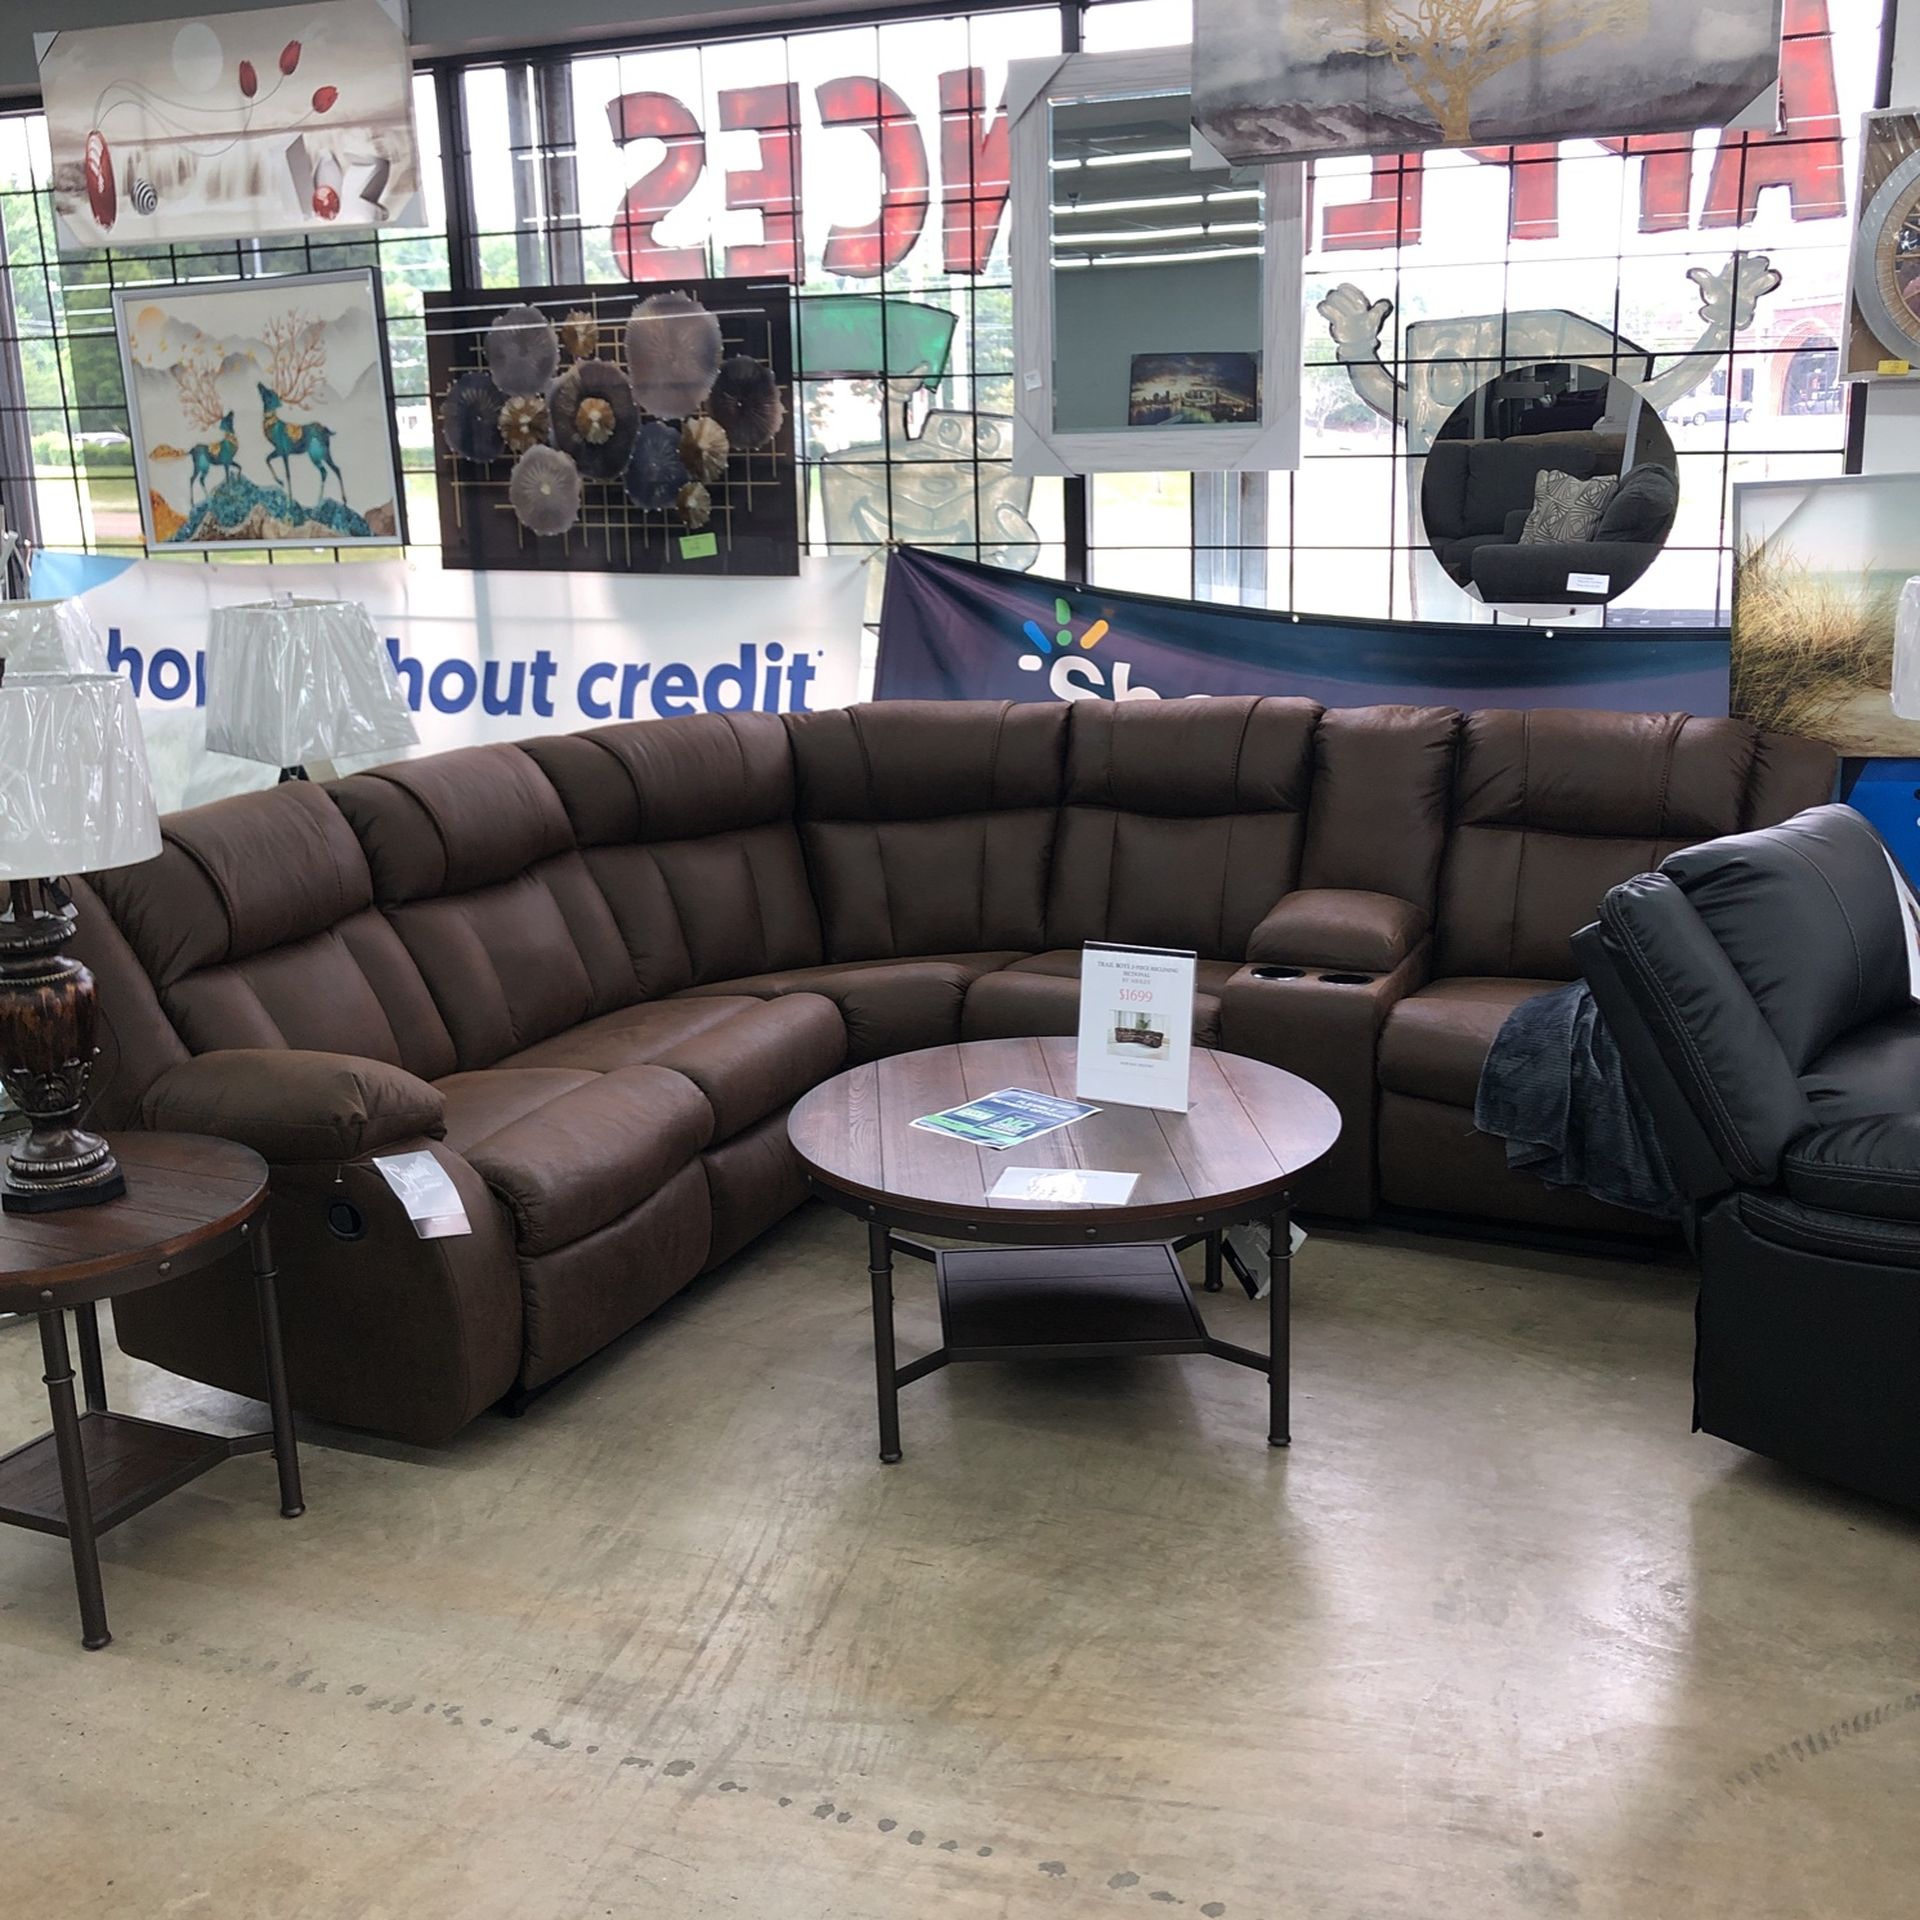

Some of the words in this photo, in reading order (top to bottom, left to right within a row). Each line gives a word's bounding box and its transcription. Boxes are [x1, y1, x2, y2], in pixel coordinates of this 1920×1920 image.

[385, 638, 558, 717] hout
[577, 642, 817, 719] credit
[1119, 988, 1153, 1002] $1699
